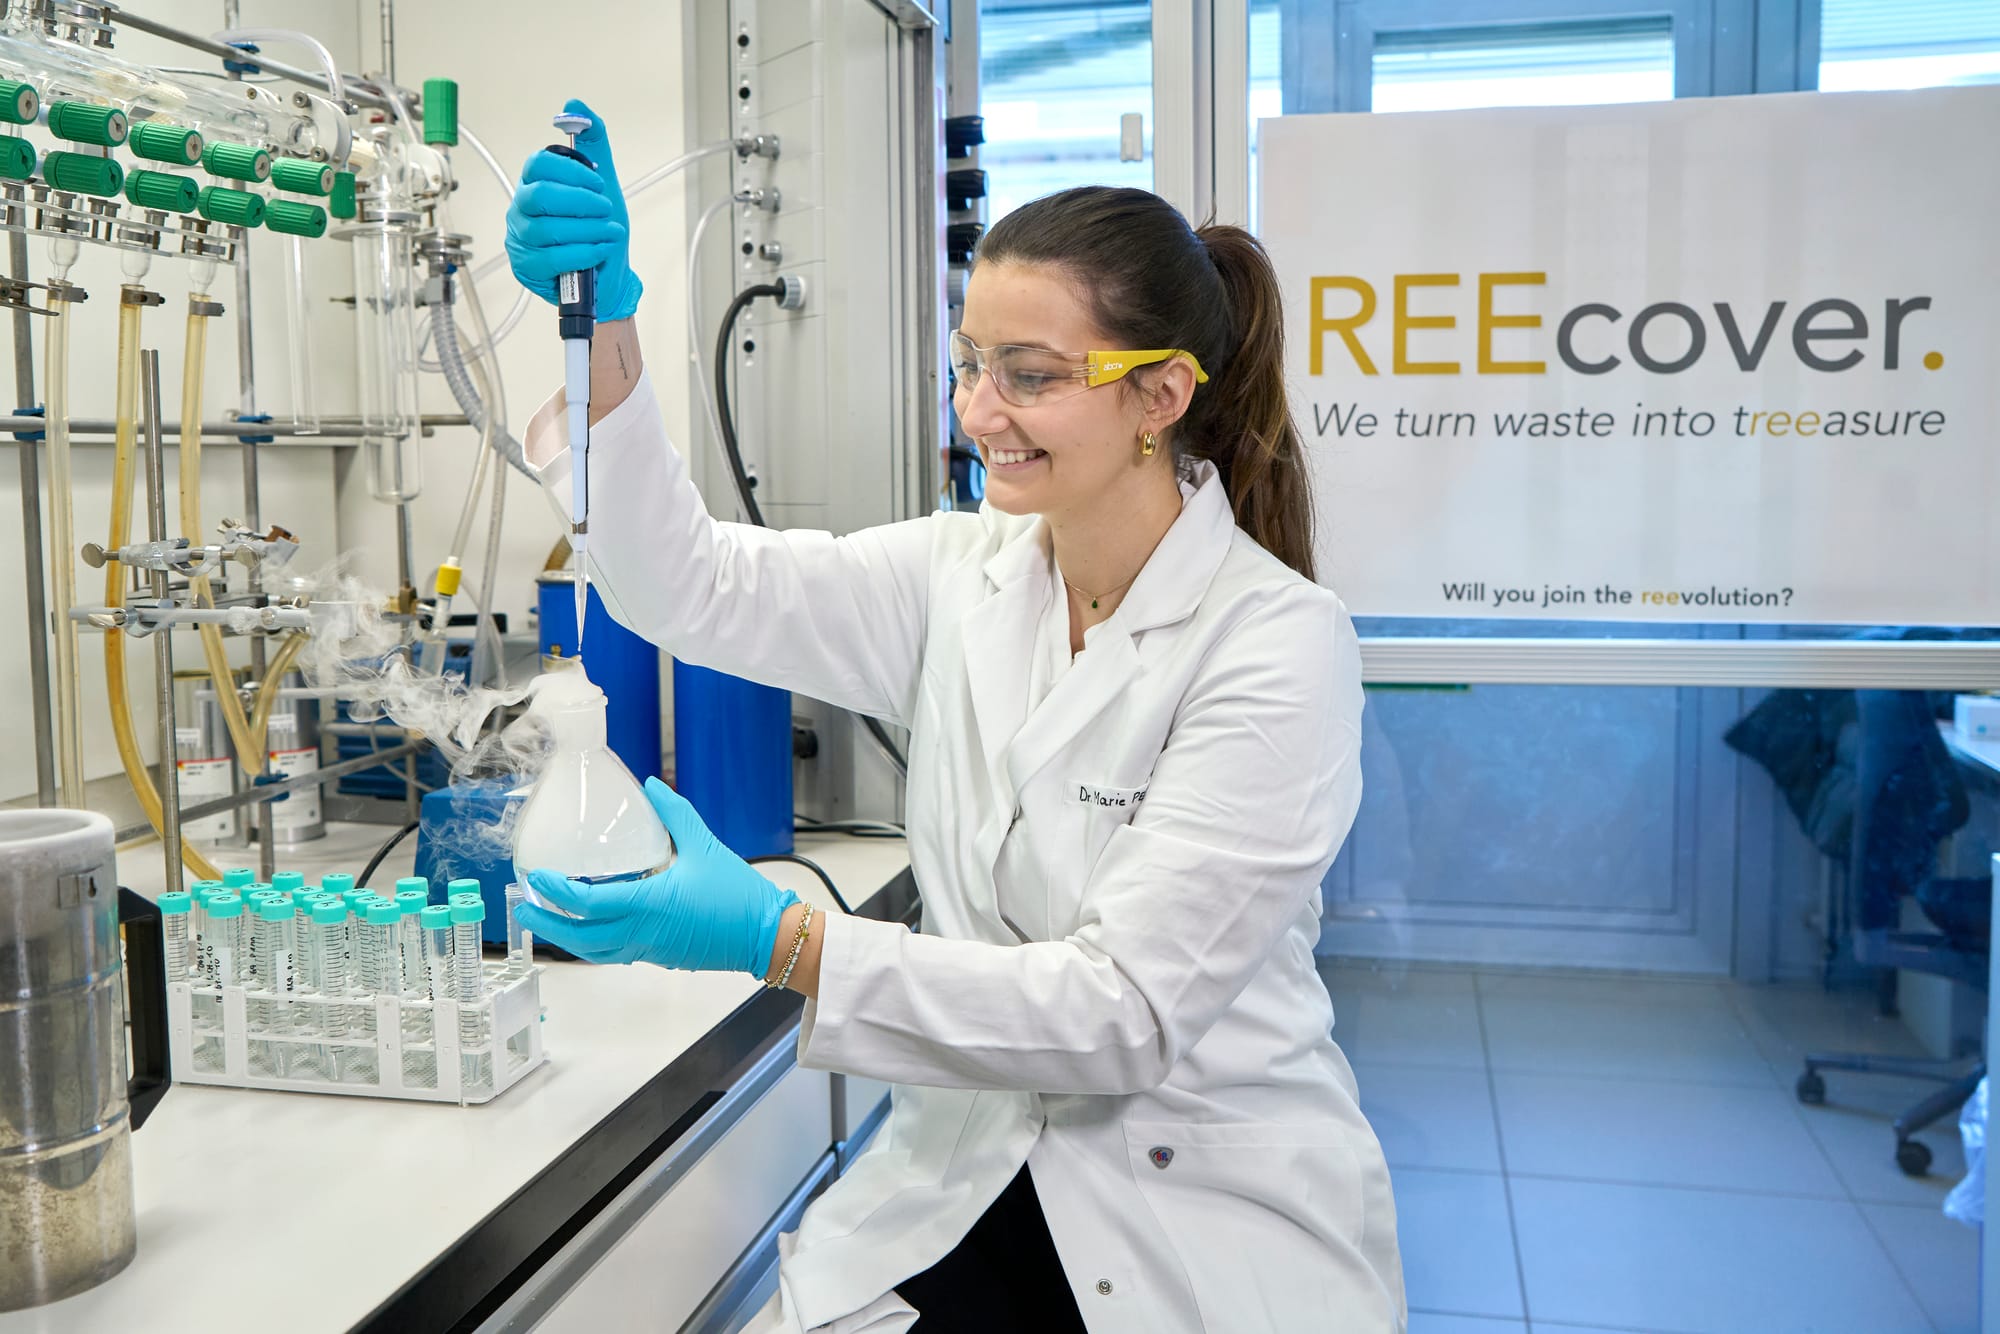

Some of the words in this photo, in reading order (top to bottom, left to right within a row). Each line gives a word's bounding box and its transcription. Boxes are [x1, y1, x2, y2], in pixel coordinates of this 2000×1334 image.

[1308, 270, 1945, 377] REEcover.
[1313, 402, 1379, 438] We
[1394, 407, 1476, 438] turn
[1493, 407, 1615, 438] waste
[1631, 402, 1716, 437] into
[1733, 405, 1946, 438] treeasure
[1442, 582, 1486, 604] Will
[1492, 588, 1535, 609] you
[1541, 583, 1587, 609] join
[1593, 583, 1633, 606] the
[1641, 585, 1795, 608] reevolution?
